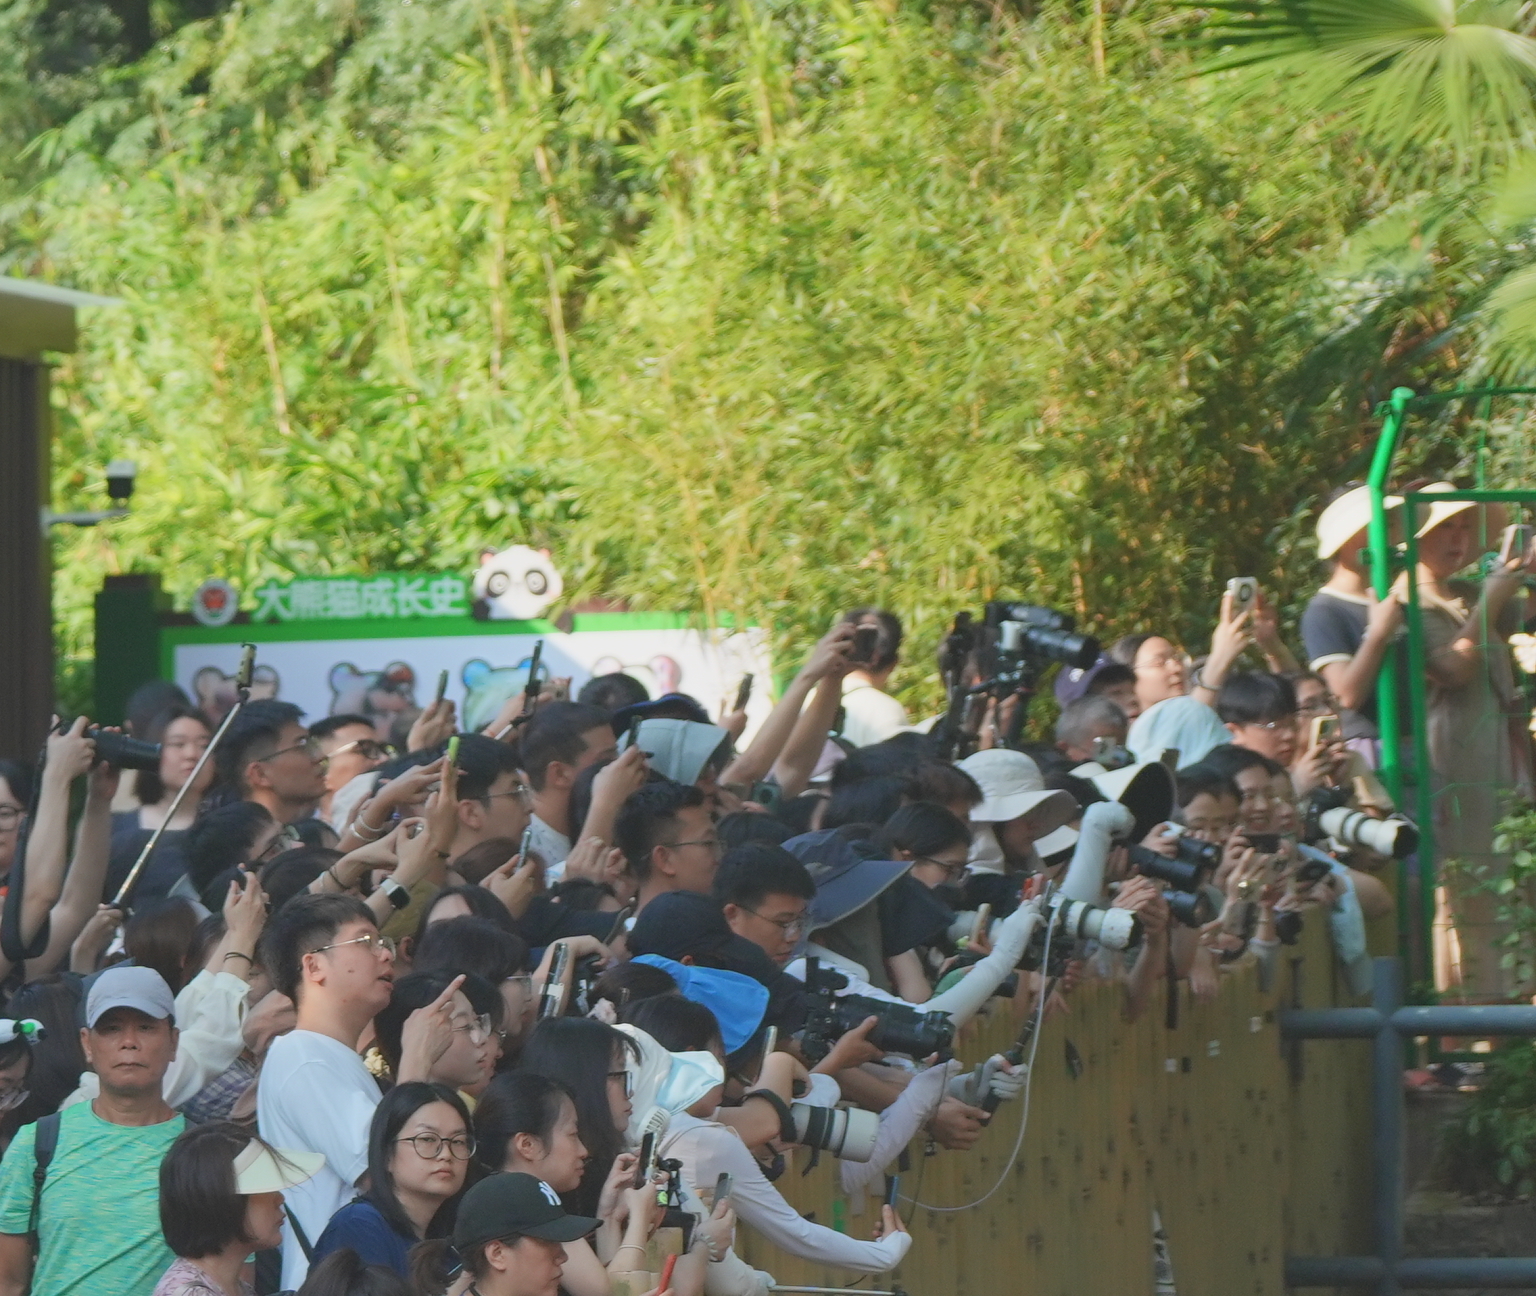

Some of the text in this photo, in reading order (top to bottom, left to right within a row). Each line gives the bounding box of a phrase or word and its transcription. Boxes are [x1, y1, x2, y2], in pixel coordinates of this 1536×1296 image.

[256, 576, 467, 620] 大熊猫成长史
